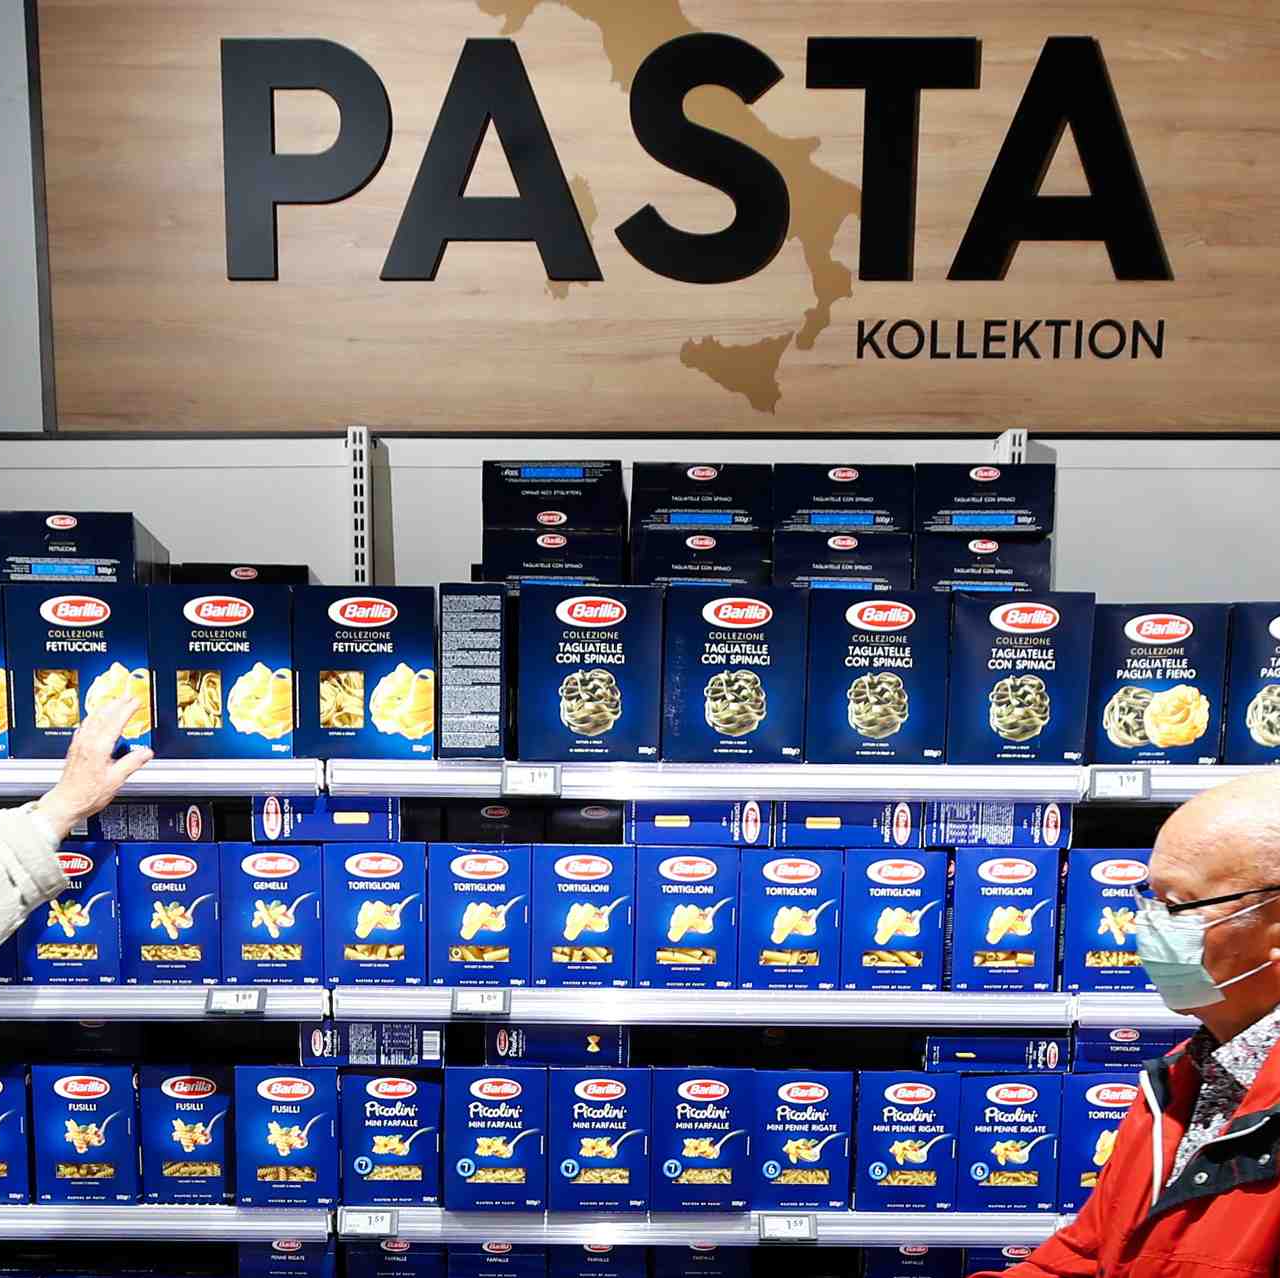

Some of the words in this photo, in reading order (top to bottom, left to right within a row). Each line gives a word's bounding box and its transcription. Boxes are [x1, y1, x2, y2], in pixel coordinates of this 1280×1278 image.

[220, 32, 1174, 284] PASTA
[855, 318, 1165, 361] KOLLEKTION
[200, 604, 248, 618] Barilla
[345, 604, 392, 619] Barilla
[572, 604, 620, 620] Barilla
[1006, 609, 1053, 626] Barilla
[1141, 618, 1188, 636] Barilla
[191, 630, 247, 639] COLLEZIONE
[335, 631, 391, 640] COLLEZIONE
[562, 631, 619, 641] COLLEZIONE
[188, 641, 250, 653] FETTUCCINE
[996, 636, 1051, 646] COLLEZIONE
[332, 642, 393, 654] FETTUCCINE
[558, 642, 623, 654] TAGLIATELLE
[991, 648, 1054, 660] TAGLIATELLE
[1130, 646, 1185, 657] COLLEZIONE
[555, 654, 581, 665] CON
[584, 654, 625, 665] SPINACI
[987, 659, 1013, 670] CON
[1016, 659, 1056, 671] SPINACI
[1126, 658, 1188, 670] TAGLIATELLE
[1116, 668, 1150, 680] PAGLIA
[1153, 668, 1159, 680] E
[1161, 668, 1196, 680] FIENO
[151, 882, 186, 892] GEMELLI
[253, 881, 288, 891] GEMELLI
[348, 881, 401, 891] TORTIGLIONI
[557, 883, 609, 893] TORTIGLIONI
[981, 887, 1033, 896] TORTIGLIONI
[481, 1083, 518, 1096] Barilla
[689, 1083, 725, 1096] Barilla
[894, 1088, 932, 1100] Barilla
[468, 1101, 523, 1119] Piccolini
[676, 1102, 730, 1120] Piccolini
[883, 1106, 937, 1124] Piccolini
[468, 1120, 485, 1129] MINI
[486, 1120, 523, 1129] FARFALLE
[676, 1121, 693, 1130] MINI
[694, 1121, 730, 1130] FARFALLE
[872, 1125, 890, 1133] MINI
[892, 1125, 916, 1133] PENNE
[918, 1125, 945, 1134] RIGATE
[461, 1161, 471, 1173] 7
[873, 1165, 883, 1177] 6
